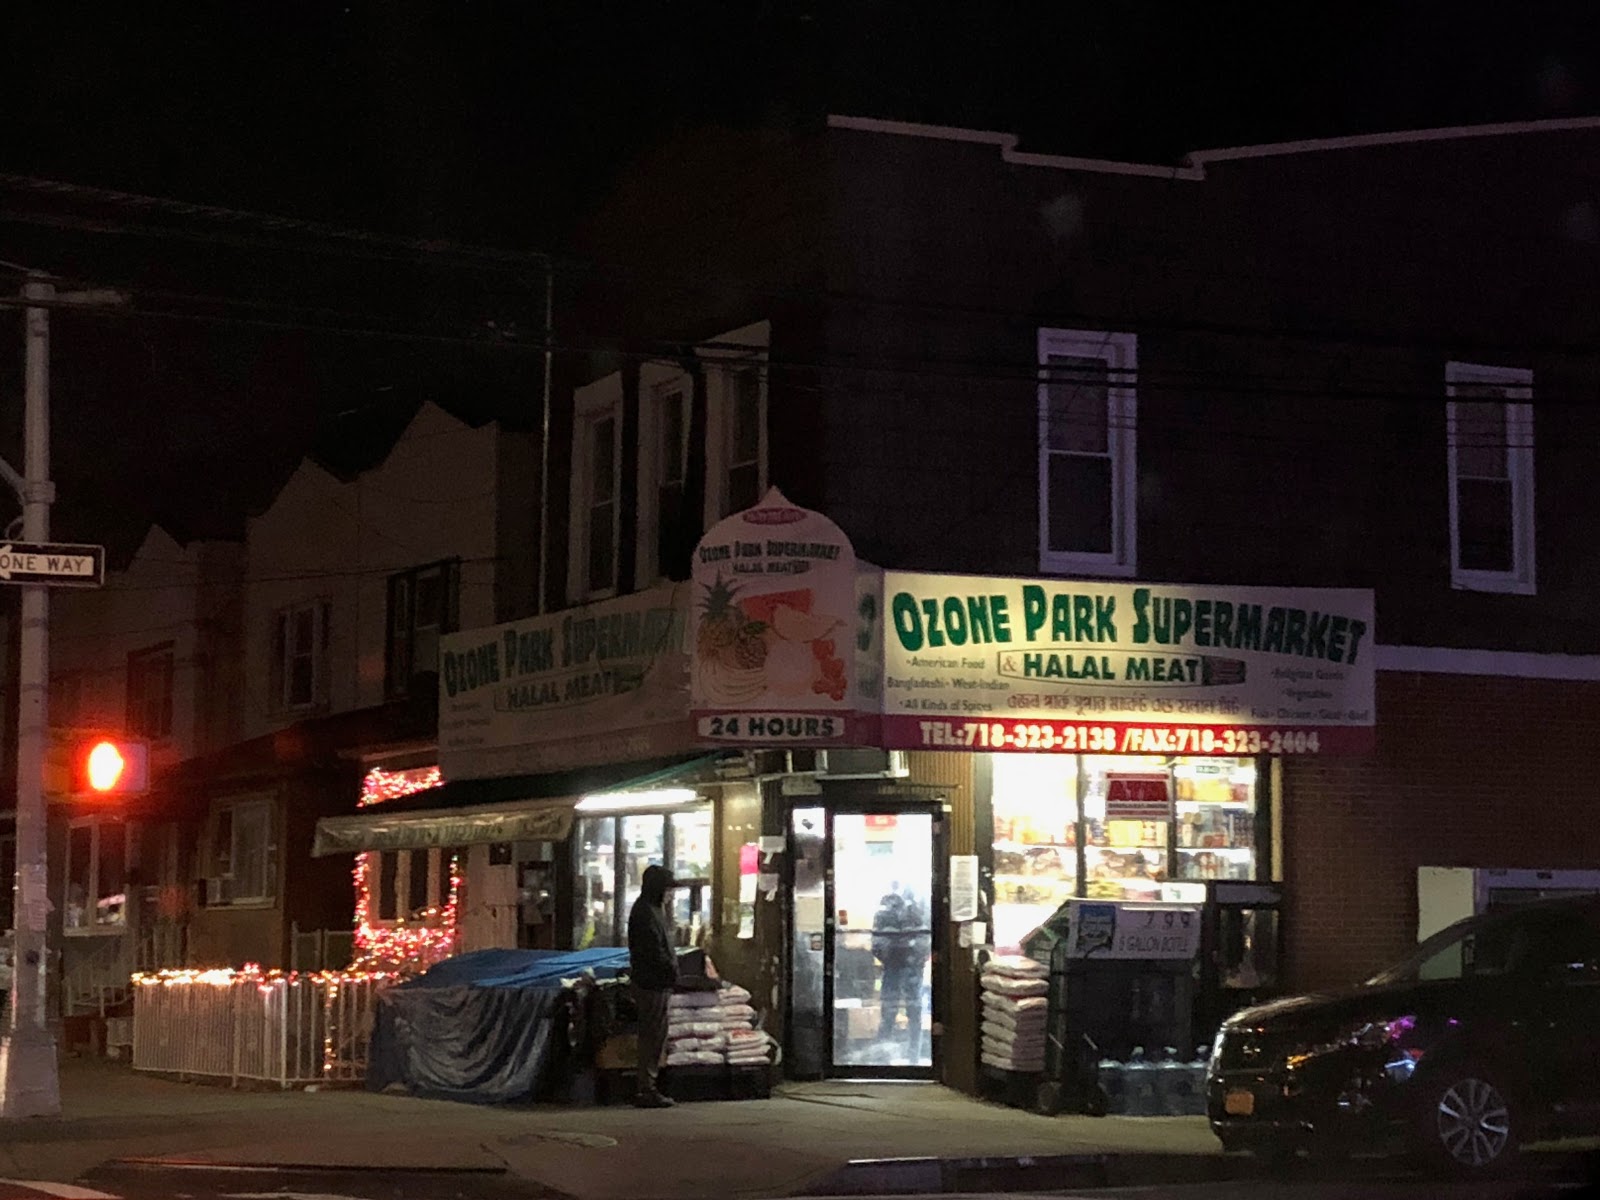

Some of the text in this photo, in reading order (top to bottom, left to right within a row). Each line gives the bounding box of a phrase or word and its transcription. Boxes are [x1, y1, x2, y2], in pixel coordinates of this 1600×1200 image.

[0, 554, 86, 573] ONE WAY
[892, 592, 1012, 652] OZONE
[1022, 585, 1117, 643] PARK
[1132, 588, 1367, 665] SUPERMARKET
[444, 641, 500, 698] OZONE
[503, 628, 554, 678] PARK
[961, 657, 985, 669] Food
[1002, 653, 1199, 682] & HALAL MEAT
[710, 717, 835, 737] 24 HOURS
